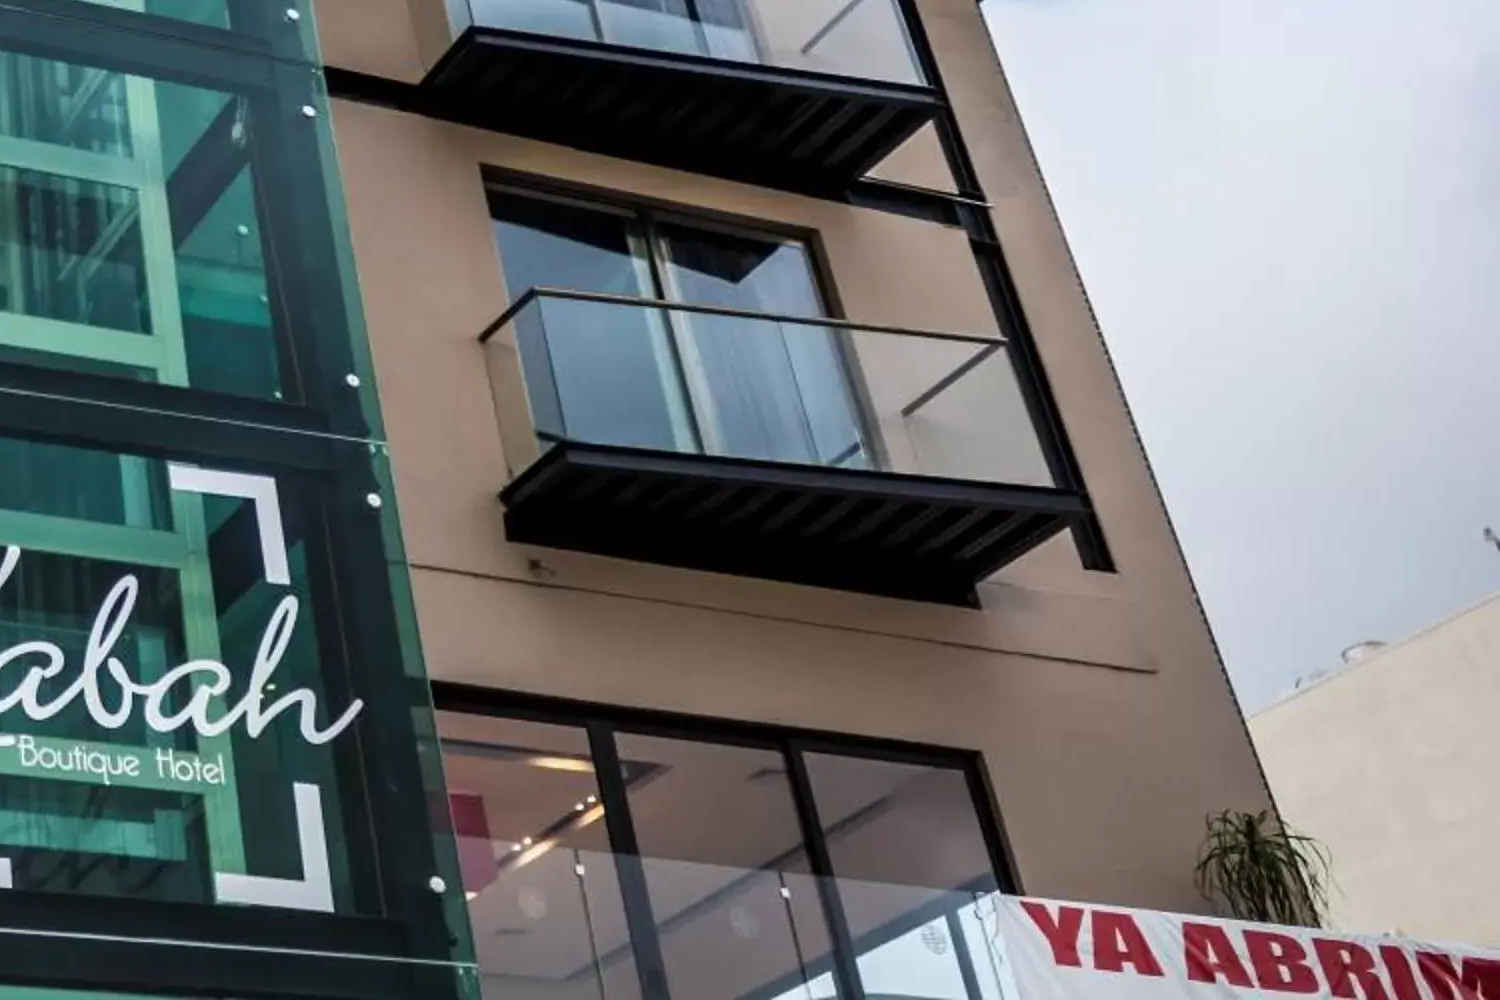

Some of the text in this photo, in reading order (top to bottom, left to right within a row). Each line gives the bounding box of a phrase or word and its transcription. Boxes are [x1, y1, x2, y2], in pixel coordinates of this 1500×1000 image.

[17, 734, 226, 786] Boutique Hotel
[1020, 901, 1164, 977] YA
